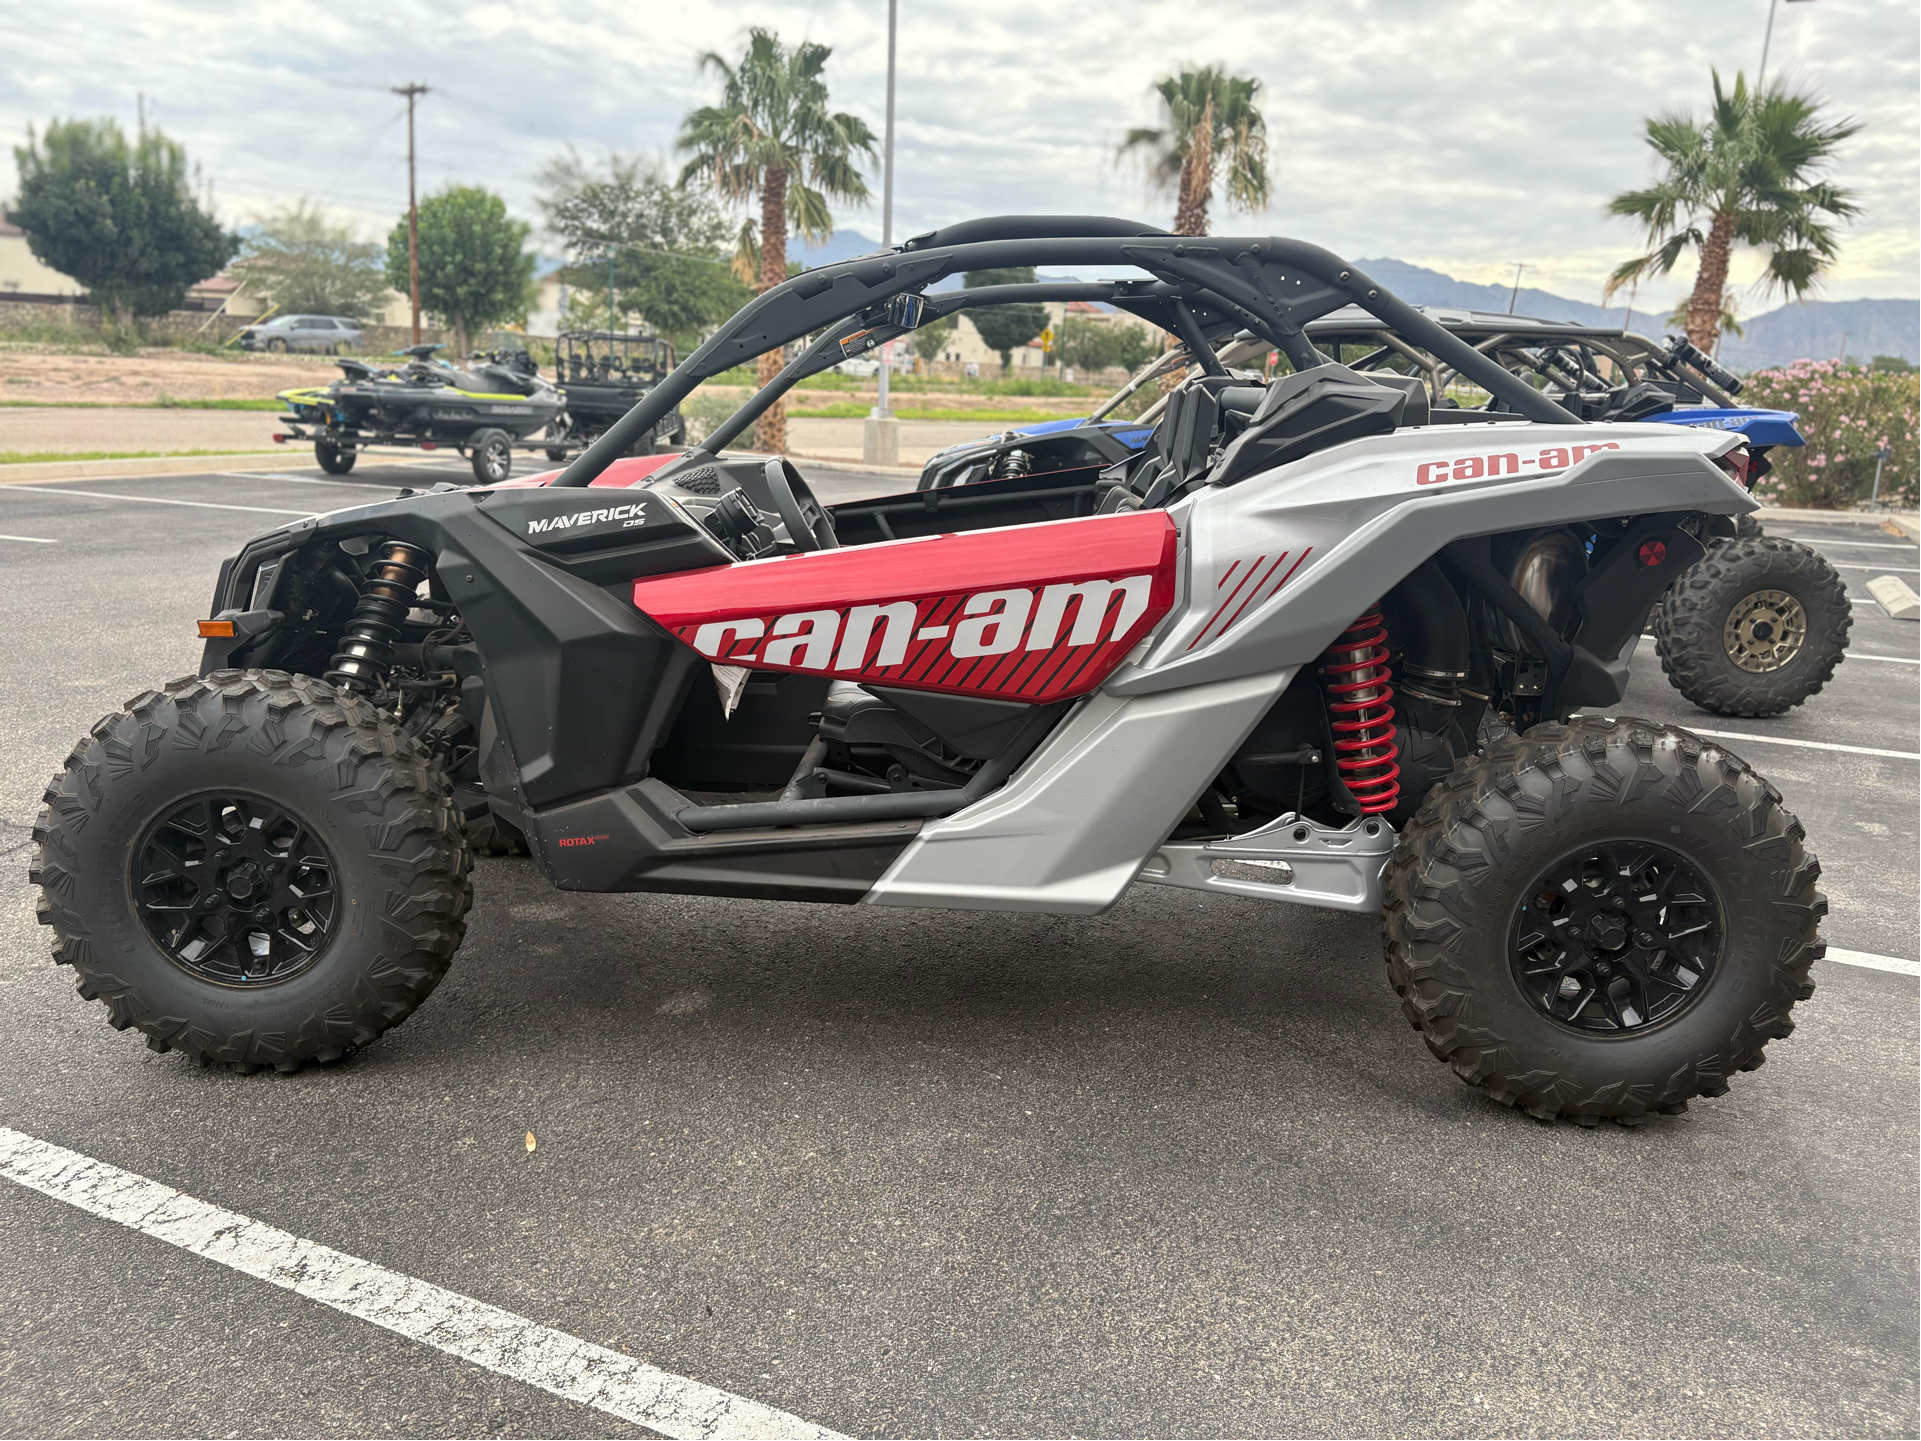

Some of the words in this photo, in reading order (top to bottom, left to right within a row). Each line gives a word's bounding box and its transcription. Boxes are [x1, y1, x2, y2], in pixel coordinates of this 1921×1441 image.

[528, 502, 648, 534] MAVERICK
[622, 518, 646, 528] DS
[693, 574, 1153, 671] can-am
[559, 836, 596, 847] ROTAX
